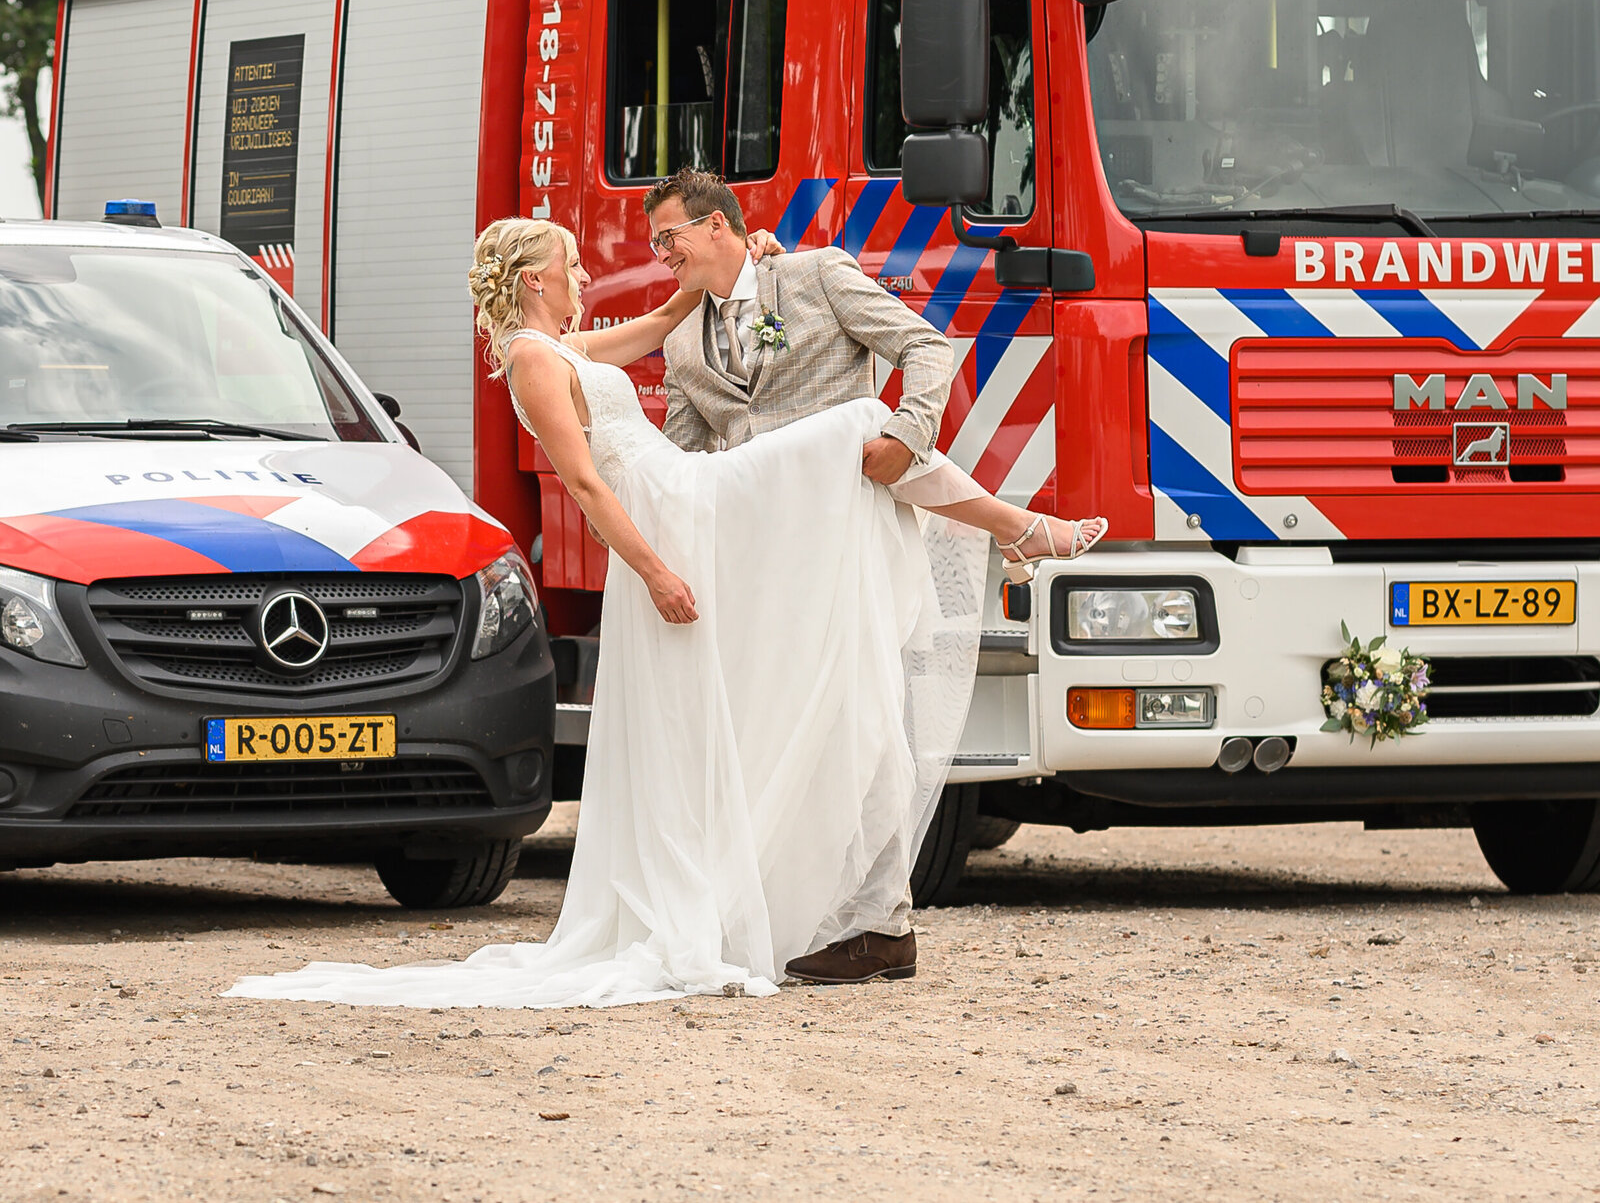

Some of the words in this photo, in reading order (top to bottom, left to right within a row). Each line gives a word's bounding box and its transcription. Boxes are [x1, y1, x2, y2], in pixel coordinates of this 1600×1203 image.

[234, 63, 277, 82] ATTENTIE!
[232, 98, 248, 114] WIJ
[250, 95, 280, 113] ZOEKEN
[531, 0, 562, 219] 18-7531
[231, 114, 279, 133] BRANDWEER-
[230, 130, 293, 151] VRIJWILLIGERS
[229, 171, 240, 188] IN
[227, 187, 275, 206] GOUDRIAAN!
[1394, 373, 1568, 410] MAN
[105, 469, 323, 485] POLITIE
[1422, 588, 1561, 618] BX-LZ-89
[1394, 608, 1407, 618] NL
[237, 722, 384, 755] R-005-ZT
[210, 744, 223, 754] NL
